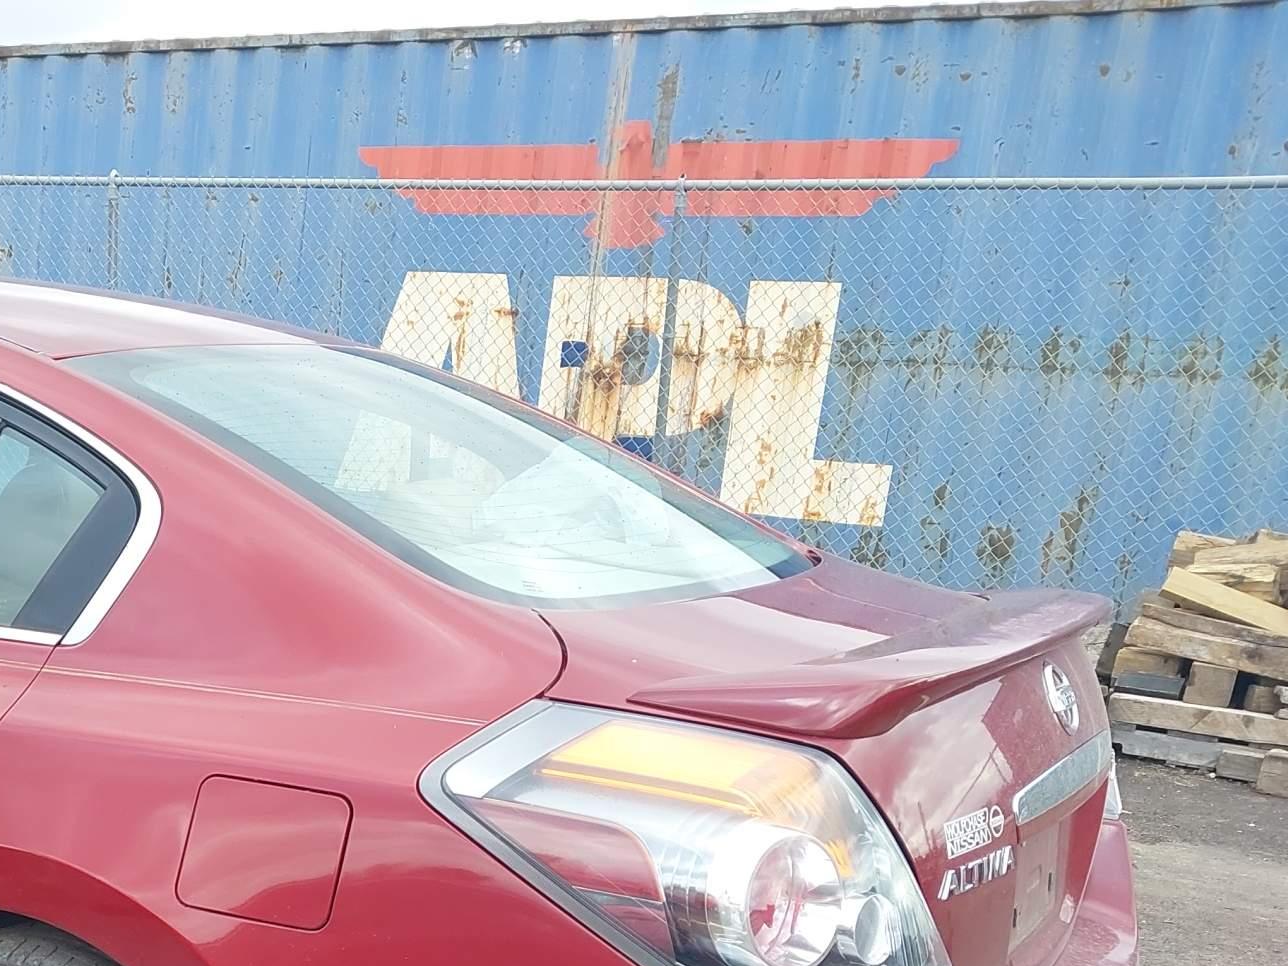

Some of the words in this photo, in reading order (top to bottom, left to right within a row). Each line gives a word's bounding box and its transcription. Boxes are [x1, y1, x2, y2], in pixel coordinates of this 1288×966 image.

[380, 270, 892, 527] APL
[949, 828, 991, 856] NISSAN
[937, 845, 1015, 900] ALTIMA
